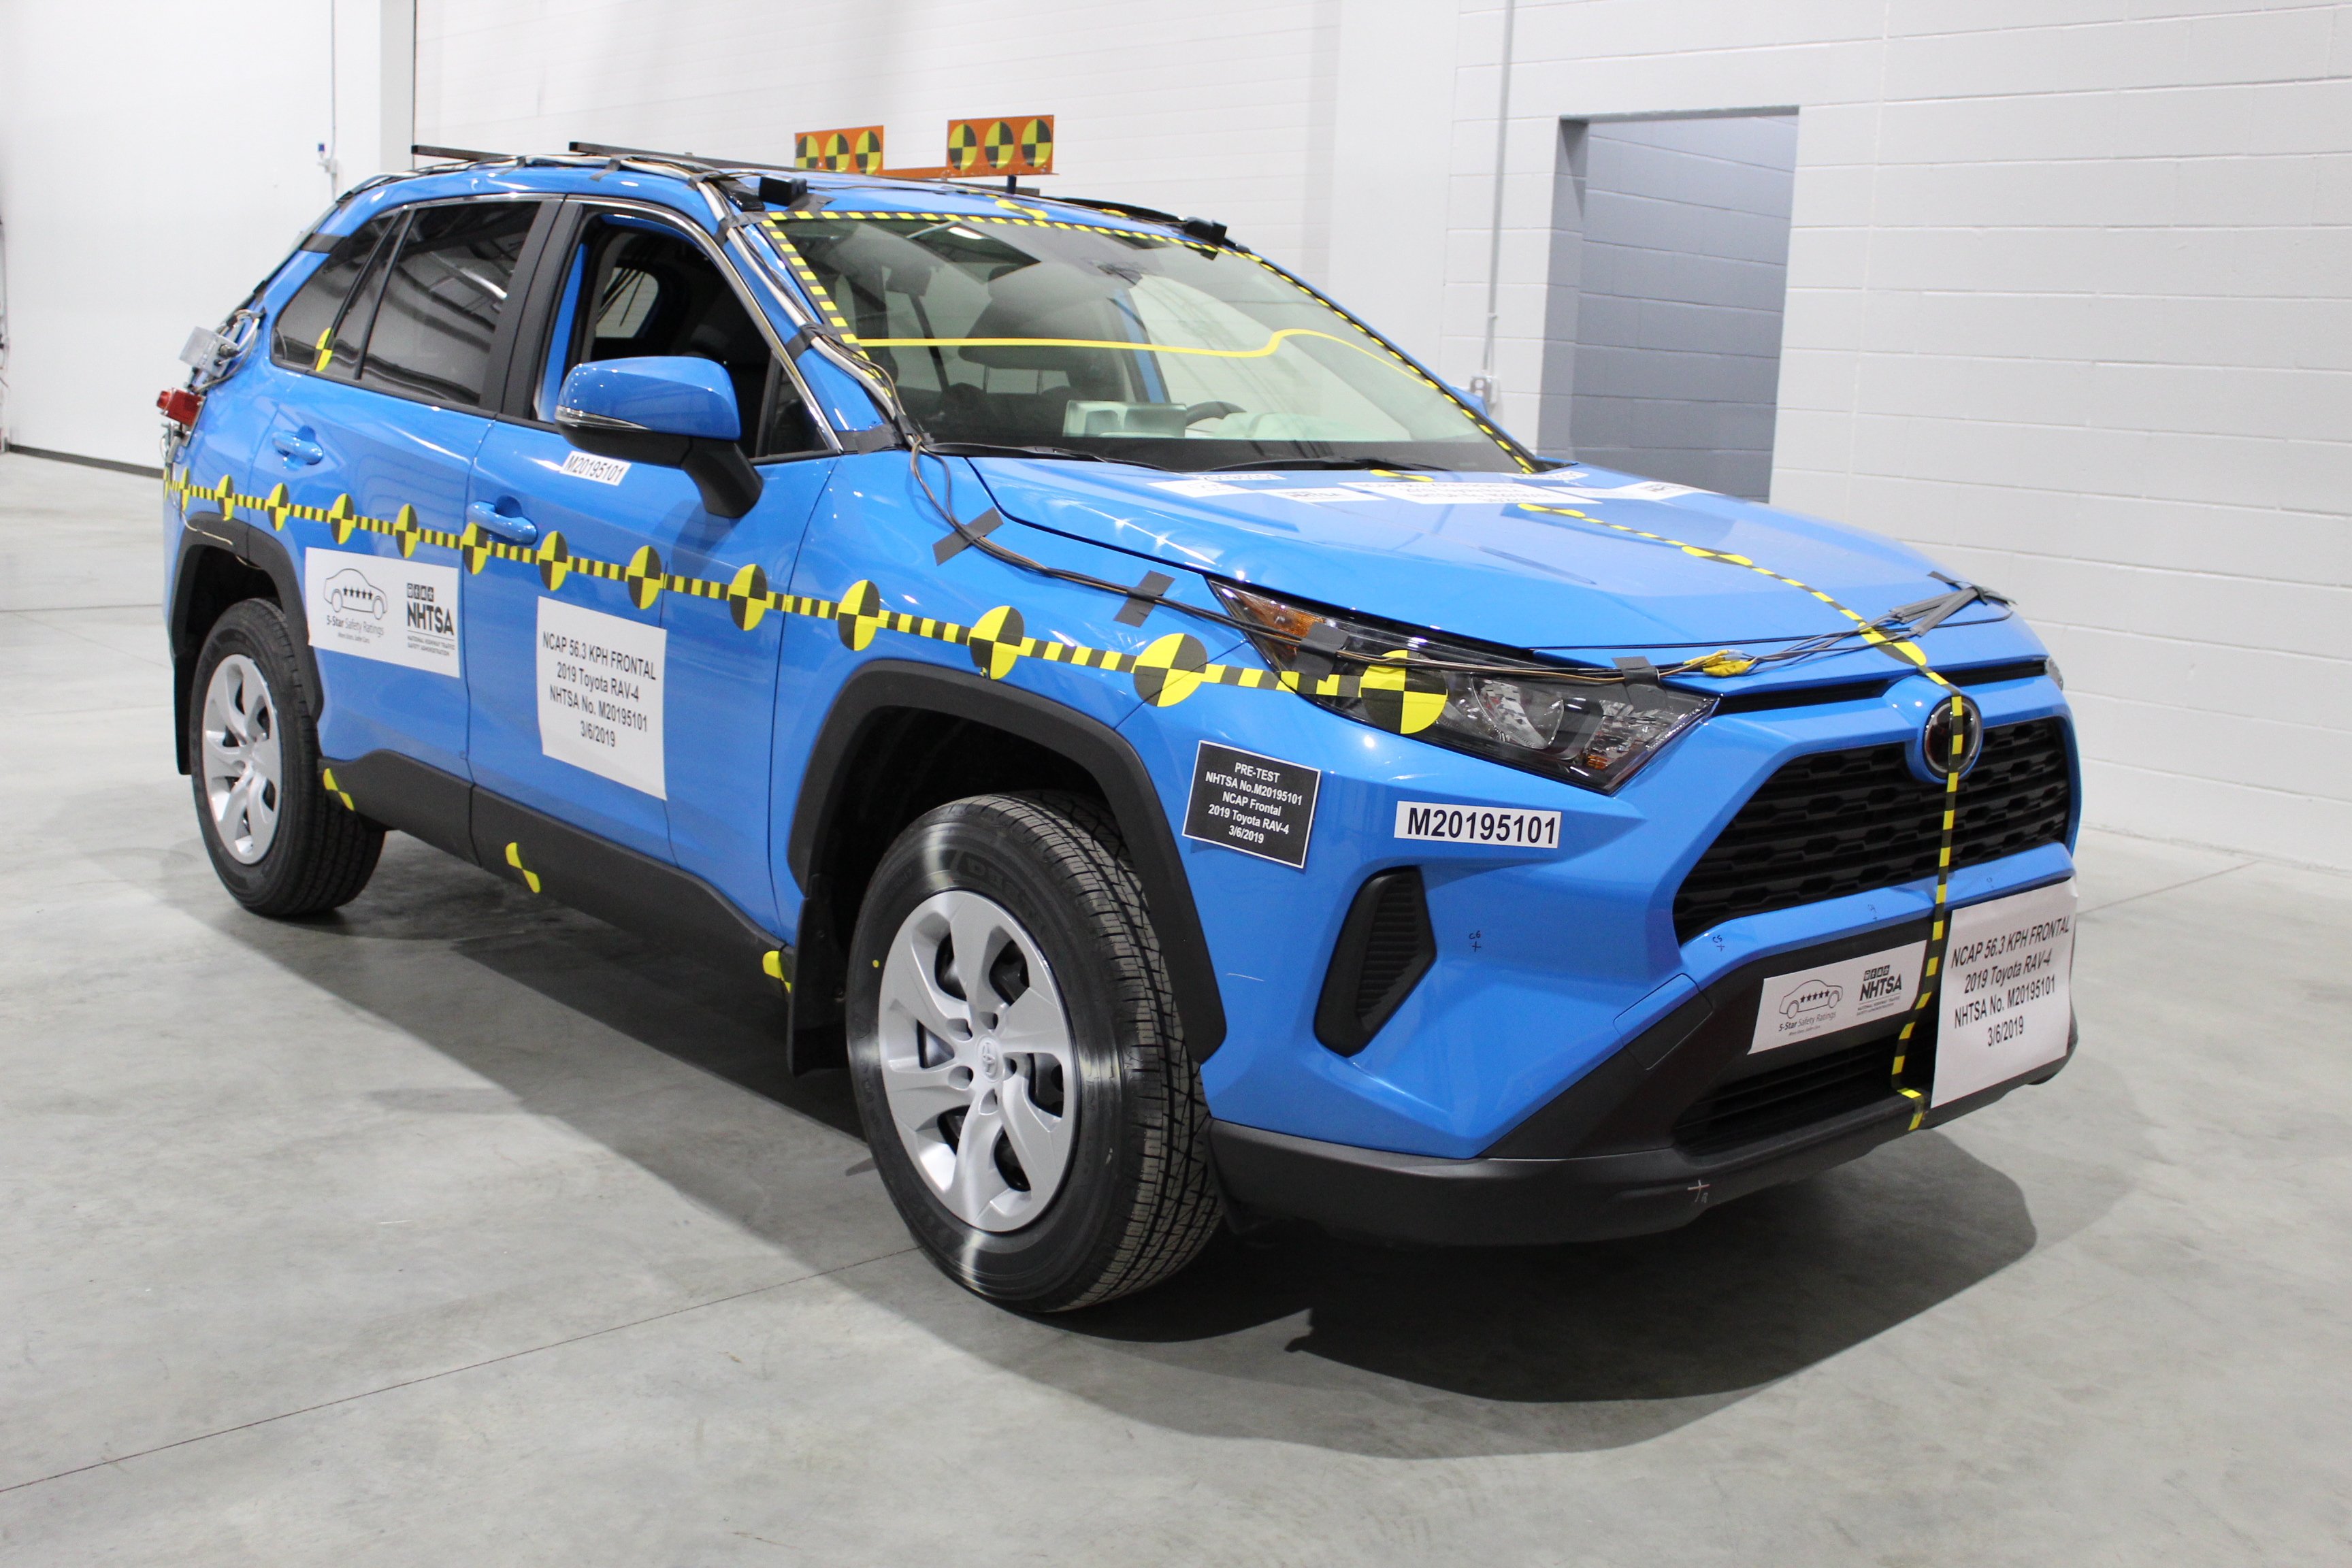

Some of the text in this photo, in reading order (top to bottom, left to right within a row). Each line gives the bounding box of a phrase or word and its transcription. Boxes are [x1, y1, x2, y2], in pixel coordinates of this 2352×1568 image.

[564, 455, 625, 483] M20195101
[407, 601, 455, 636] NHTSA
[542, 631, 656, 681] NCAP 56.3 KPH FRONTAL
[557, 662, 639, 702] 2019 Toyota RAV-4
[549, 684, 647, 732] NHTSA No. M20195101
[580, 720, 616, 748] 3/6/2019
[1205, 771, 1238, 789] NHTSA
[1235, 762, 1280, 783] PRE-TEST
[1208, 804, 1290, 834] 2019 Toyota RAV-4
[1222, 791, 1281, 817] NCAP Frontal
[1228, 825, 1264, 844] 3/6/2019
[1407, 807, 1555, 844] M20195101
[1950, 915, 2070, 968] NCAP 56.3 KPH FRONTAL
[1964, 948, 2053, 994] 2019 Toyota RAV-4
[1859, 974, 1902, 1001] NHTSA
[1955, 974, 2055, 1029] NHTSA No. M20195101
[1778, 1022, 1798, 1032] 5-Star
[1988, 1015, 2024, 1047] 3/6/2019
